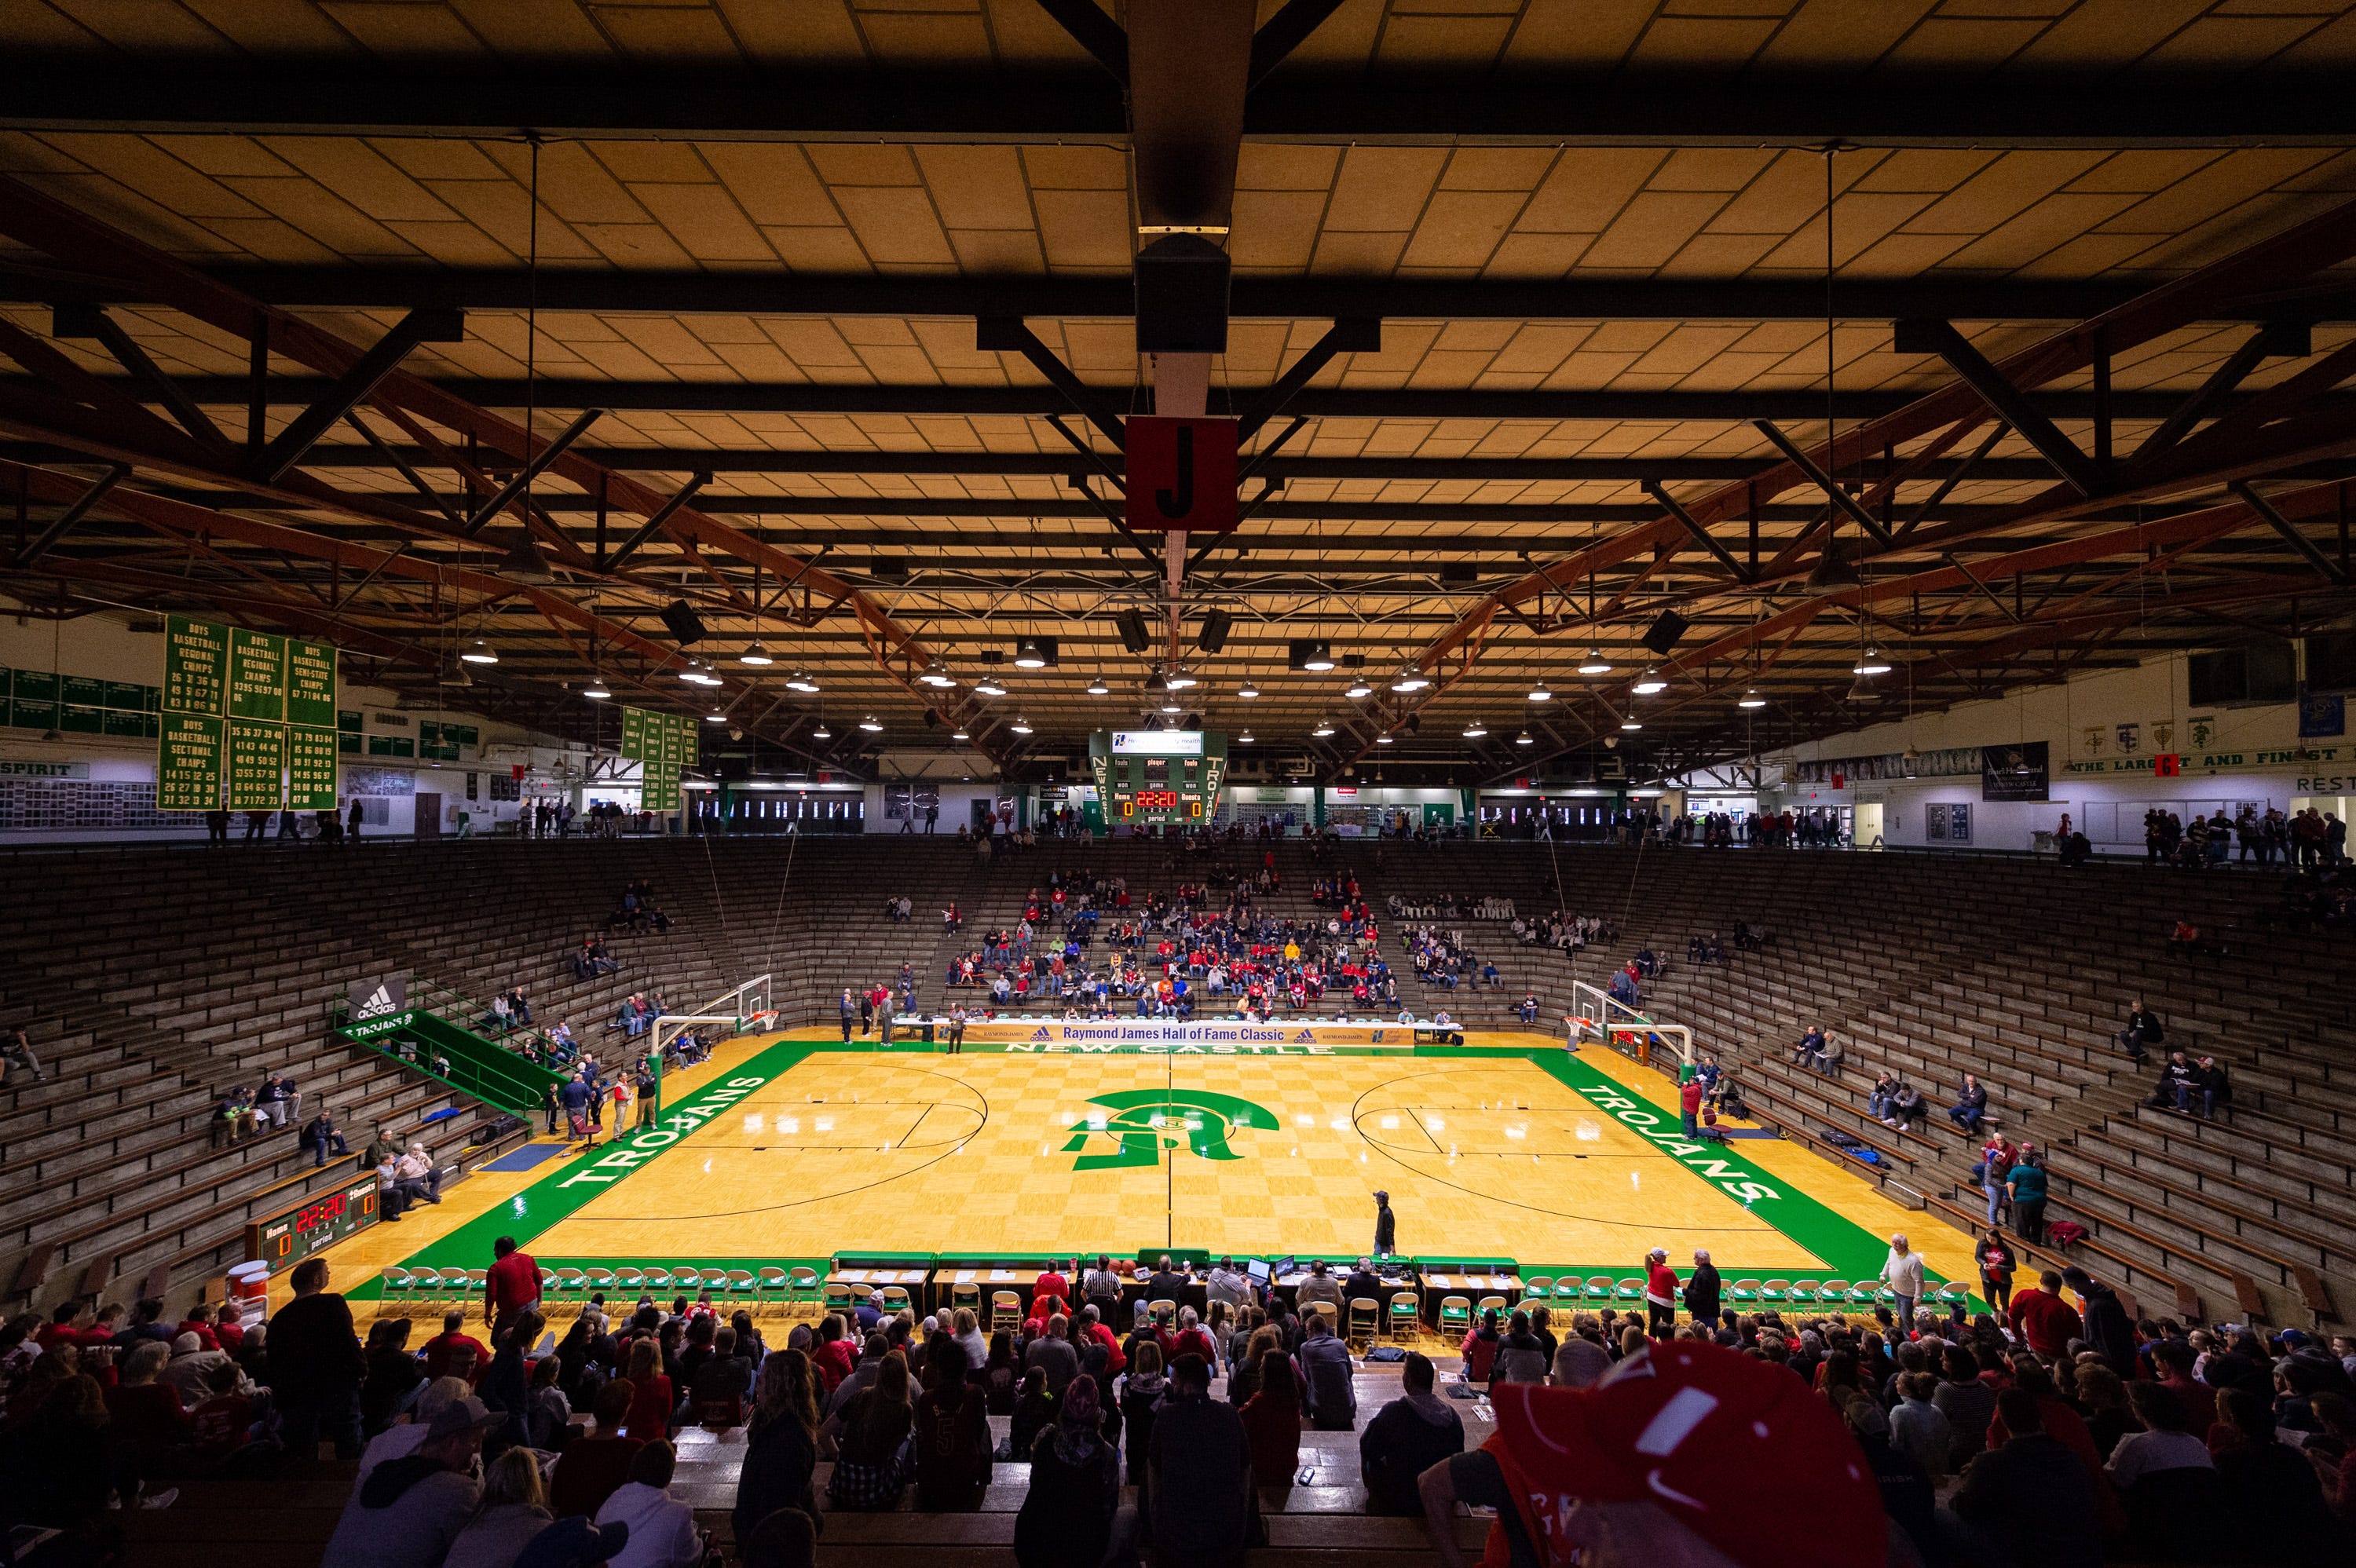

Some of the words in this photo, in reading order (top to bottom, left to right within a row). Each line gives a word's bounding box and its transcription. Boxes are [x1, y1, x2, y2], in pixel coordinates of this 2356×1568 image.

[1155, 426, 1194, 519] J
[189, 623, 209, 636] BOYS
[174, 634, 221, 651] BASKETBALL
[251, 636, 269, 647] BOYS
[179, 648, 214, 663] REGONAL
[237, 645, 280, 661] BASKETBALL
[305, 647, 320, 656] BOYS
[243, 660, 276, 672] REGIONAL
[293, 656, 331, 670] BASKETBALL
[172, 672, 181, 682] 26
[196, 676, 207, 685] 36
[245, 671, 272, 683] CHAMPS
[294, 667, 328, 680] SEMI-STATE
[263, 686, 272, 695] 97
[301, 680, 324, 690] CHAMPS
[196, 689, 207, 697] 67
[303, 691, 311, 700] 71
[194, 700, 206, 709] 86
[183, 720, 203, 730] BOYS
[168, 731, 216, 744] BASKETBALL
[232, 727, 240, 736] 35
[243, 728, 251, 736] 36
[253, 729, 262, 737] 37
[264, 729, 272, 738] 39
[236, 741, 244, 750] 41
[247, 742, 255, 751] 43
[259, 743, 267, 751] 44
[246, 755, 254, 764] 49
[258, 756, 267, 765] 50
[269, 757, 276, 766] 52
[2075, 762, 2104, 772] THE
[2114, 758, 2190, 769] LARGT
[2204, 755, 2243, 766] AND
[2257, 749, 2337, 763] FINST
[2162, 757, 2171, 775] G
[0, 762, 71, 775] SPIRIT
[166, 769, 176, 779] 14
[179, 770, 190, 779] 15
[206, 772, 215, 780] 25
[1092, 756, 1107, 784] NEW
[165, 783, 175, 791] 26
[179, 783, 190, 792] 27
[244, 783, 253, 791] 64
[256, 783, 265, 791] 65
[1205, 757, 1224, 825] TROJANS
[164, 795, 174, 804] 31
[178, 795, 190, 804] 32
[204, 796, 213, 805] 34
[255, 796, 265, 805] 72
[269, 796, 277, 805] 73
[1099, 786, 1109, 824] CASTLE
[1137, 791, 1176, 806] 22:20
[1124, 802, 1133, 817] 0
[1191, 802, 1202, 817] 0
[358, 1003, 396, 1019] adidas
[356, 1018, 402, 1036] TROJANS
[1063, 1027, 1118, 1041] Raymond
[1121, 1028, 1159, 1040] James
[1163, 1028, 1186, 1040] Hall
[1190, 1028, 1202, 1040] of
[1205, 1029, 1237, 1040] Fame
[1241, 1029, 1284, 1041] Classic
[1005, 1044, 1120, 1053] NEW
[1139, 1044, 1336, 1054] CASTLE
[556, 1076, 766, 1188] TROJANS
[1579, 1085, 1782, 1200] TROJANS
[353, 1182, 375, 1198] Guests
[364, 1194, 374, 1215] 0
[297, 1193, 346, 1234] 22:20
[267, 1223, 288, 1240] Home
[280, 1234, 291, 1256] 0
[312, 1231, 333, 1251] period
[936, 1417, 955, 1457] 5
